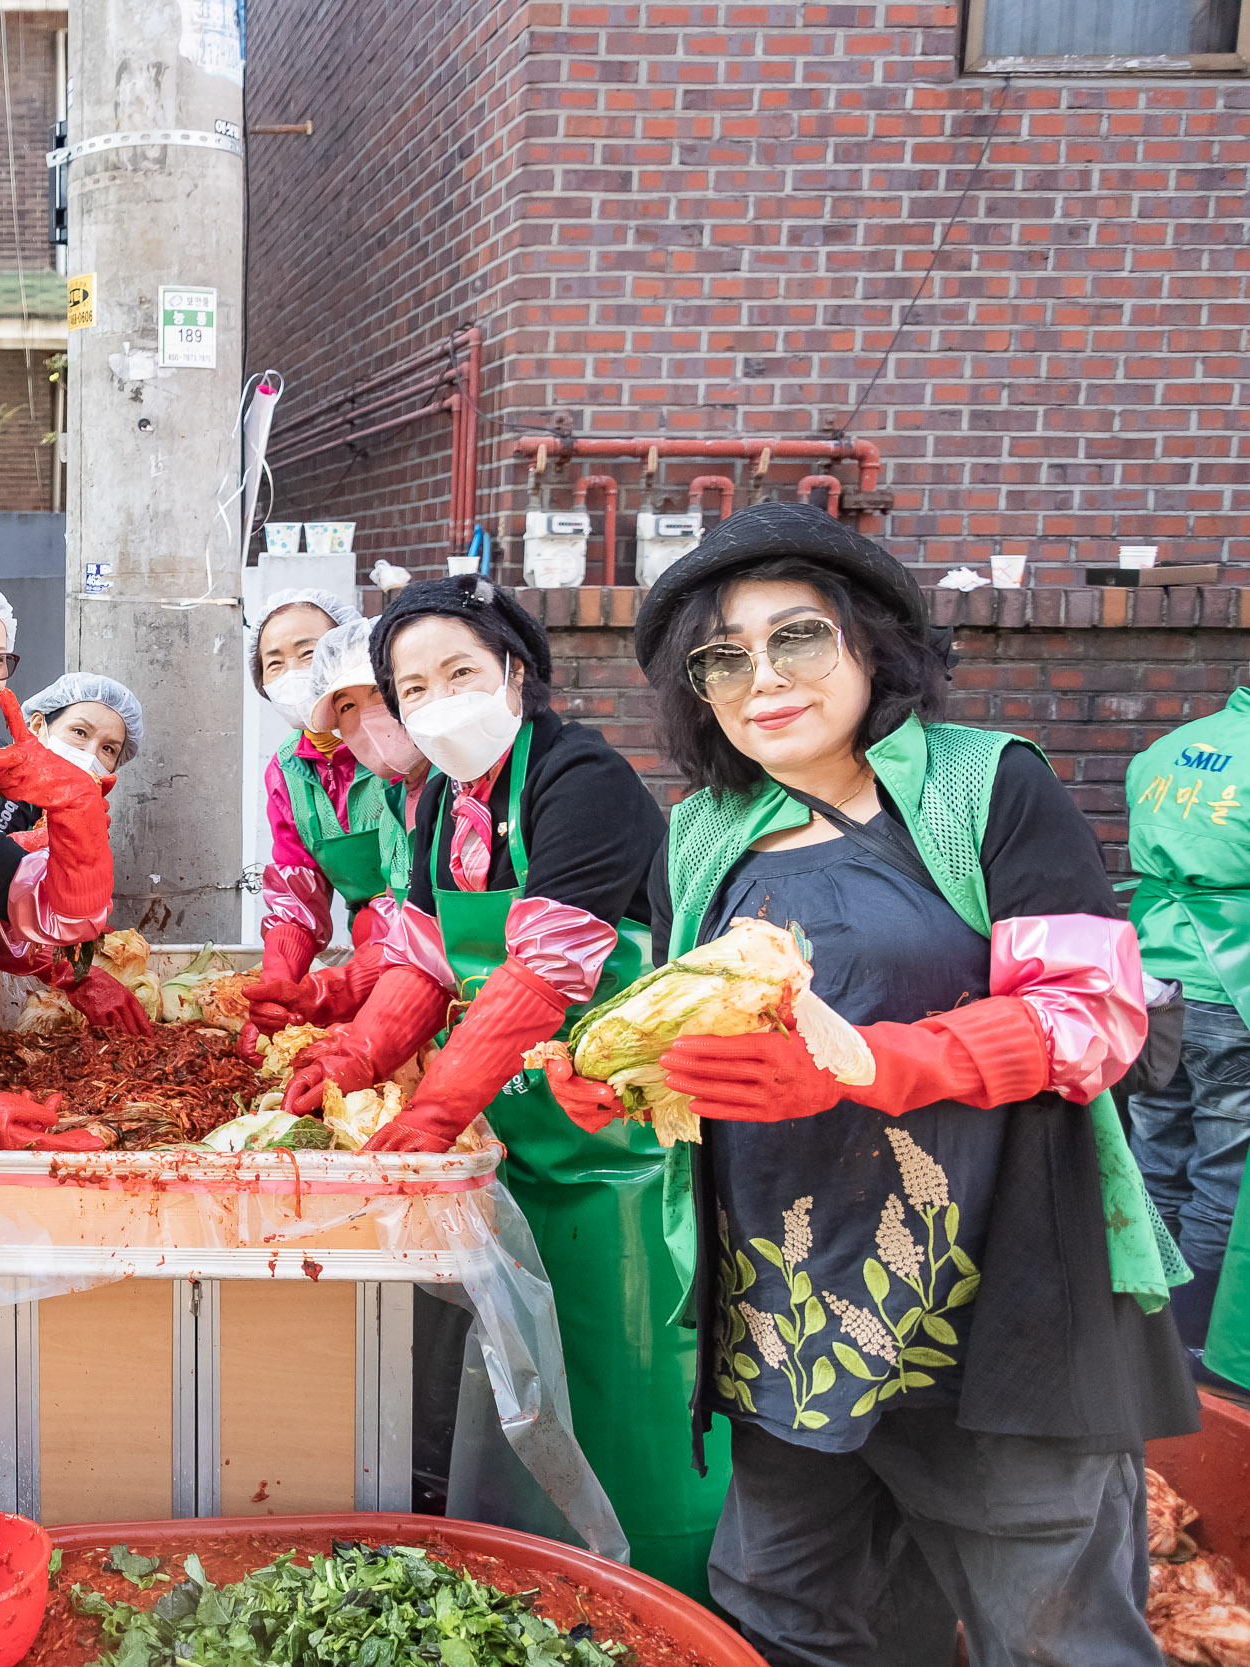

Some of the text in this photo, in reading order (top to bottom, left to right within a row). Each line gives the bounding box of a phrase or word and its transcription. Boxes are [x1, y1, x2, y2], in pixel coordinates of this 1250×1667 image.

[178, 328, 202, 343] 189
[1174, 747, 1233, 772] SMU
[1138, 774, 1241, 825] 새마을
